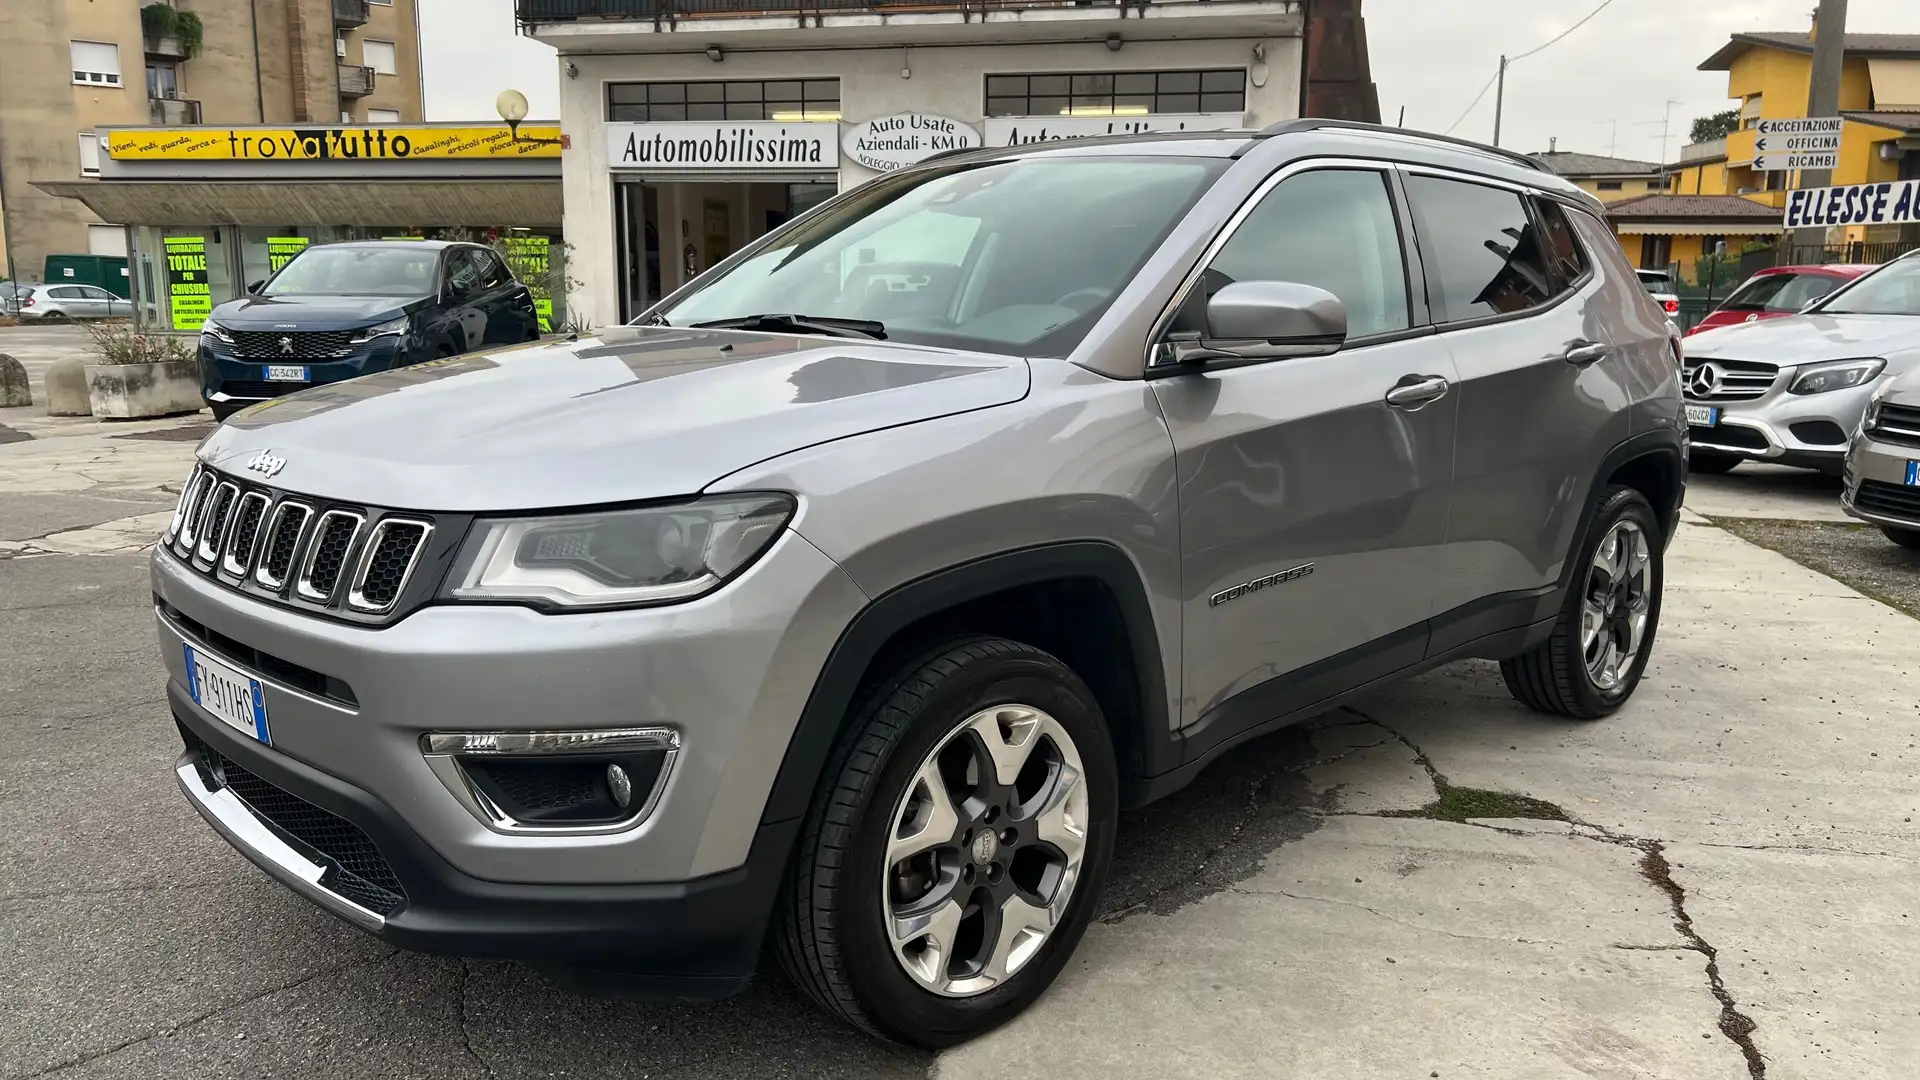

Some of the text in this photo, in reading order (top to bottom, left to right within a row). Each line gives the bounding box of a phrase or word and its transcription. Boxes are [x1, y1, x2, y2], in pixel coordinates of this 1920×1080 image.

[869, 115, 955, 136] Auto Usate
[1770, 119, 1842, 133] ACCETTAZIONE
[112, 141, 137, 153] Vieni,
[138, 141, 159, 153] vedi,
[160, 136, 192, 153] guarda,
[186, 140, 210, 153] cerca
[228, 130, 411, 158] trovatutto
[413, 135, 460, 155] Casalinghi,
[447, 138, 480, 155] articoli
[481, 131, 511, 144] regalo,
[623, 129, 821, 163] Automobilissima
[856, 135, 919, 151] Aziendali
[931, 136, 954, 150] KM
[959, 135, 968, 148] 0
[1787, 137, 1838, 149] OFFICINA
[857, 153, 900, 171] NOLEGGIO
[1788, 156, 1836, 167] RICAMBI
[1788, 183, 1892, 227] ELLESSE
[166, 244, 205, 254] LIQUIDAZIONE
[167, 255, 207, 271] TOTALE
[182, 272, 195, 280] PER
[171, 283, 210, 295] CHIUSURA
[246, 448, 288, 479] Jeep
[1208, 561, 1315, 608] COMPASS
